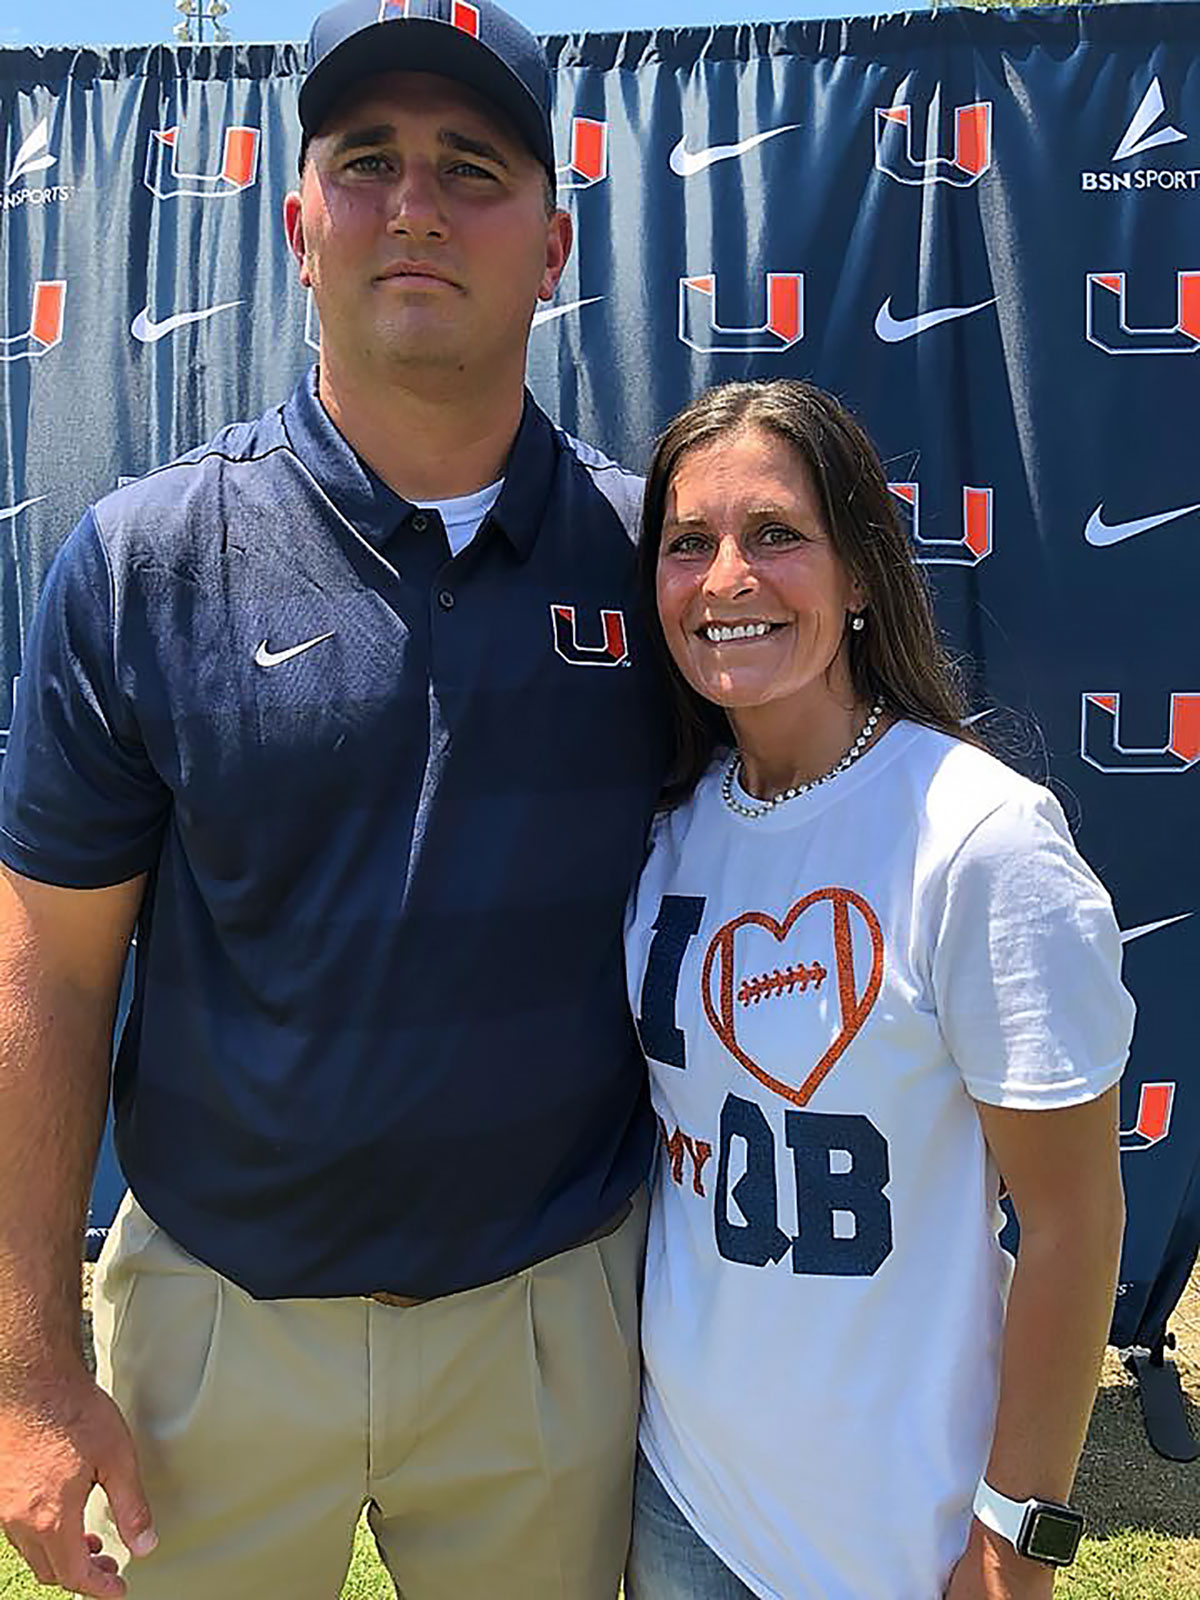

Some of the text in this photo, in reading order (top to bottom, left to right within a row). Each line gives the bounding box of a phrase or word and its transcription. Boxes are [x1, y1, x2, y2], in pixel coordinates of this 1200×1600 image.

[550, 604, 629, 667] U
[636, 895, 707, 1069] I
[714, 1092, 894, 1277] QB
